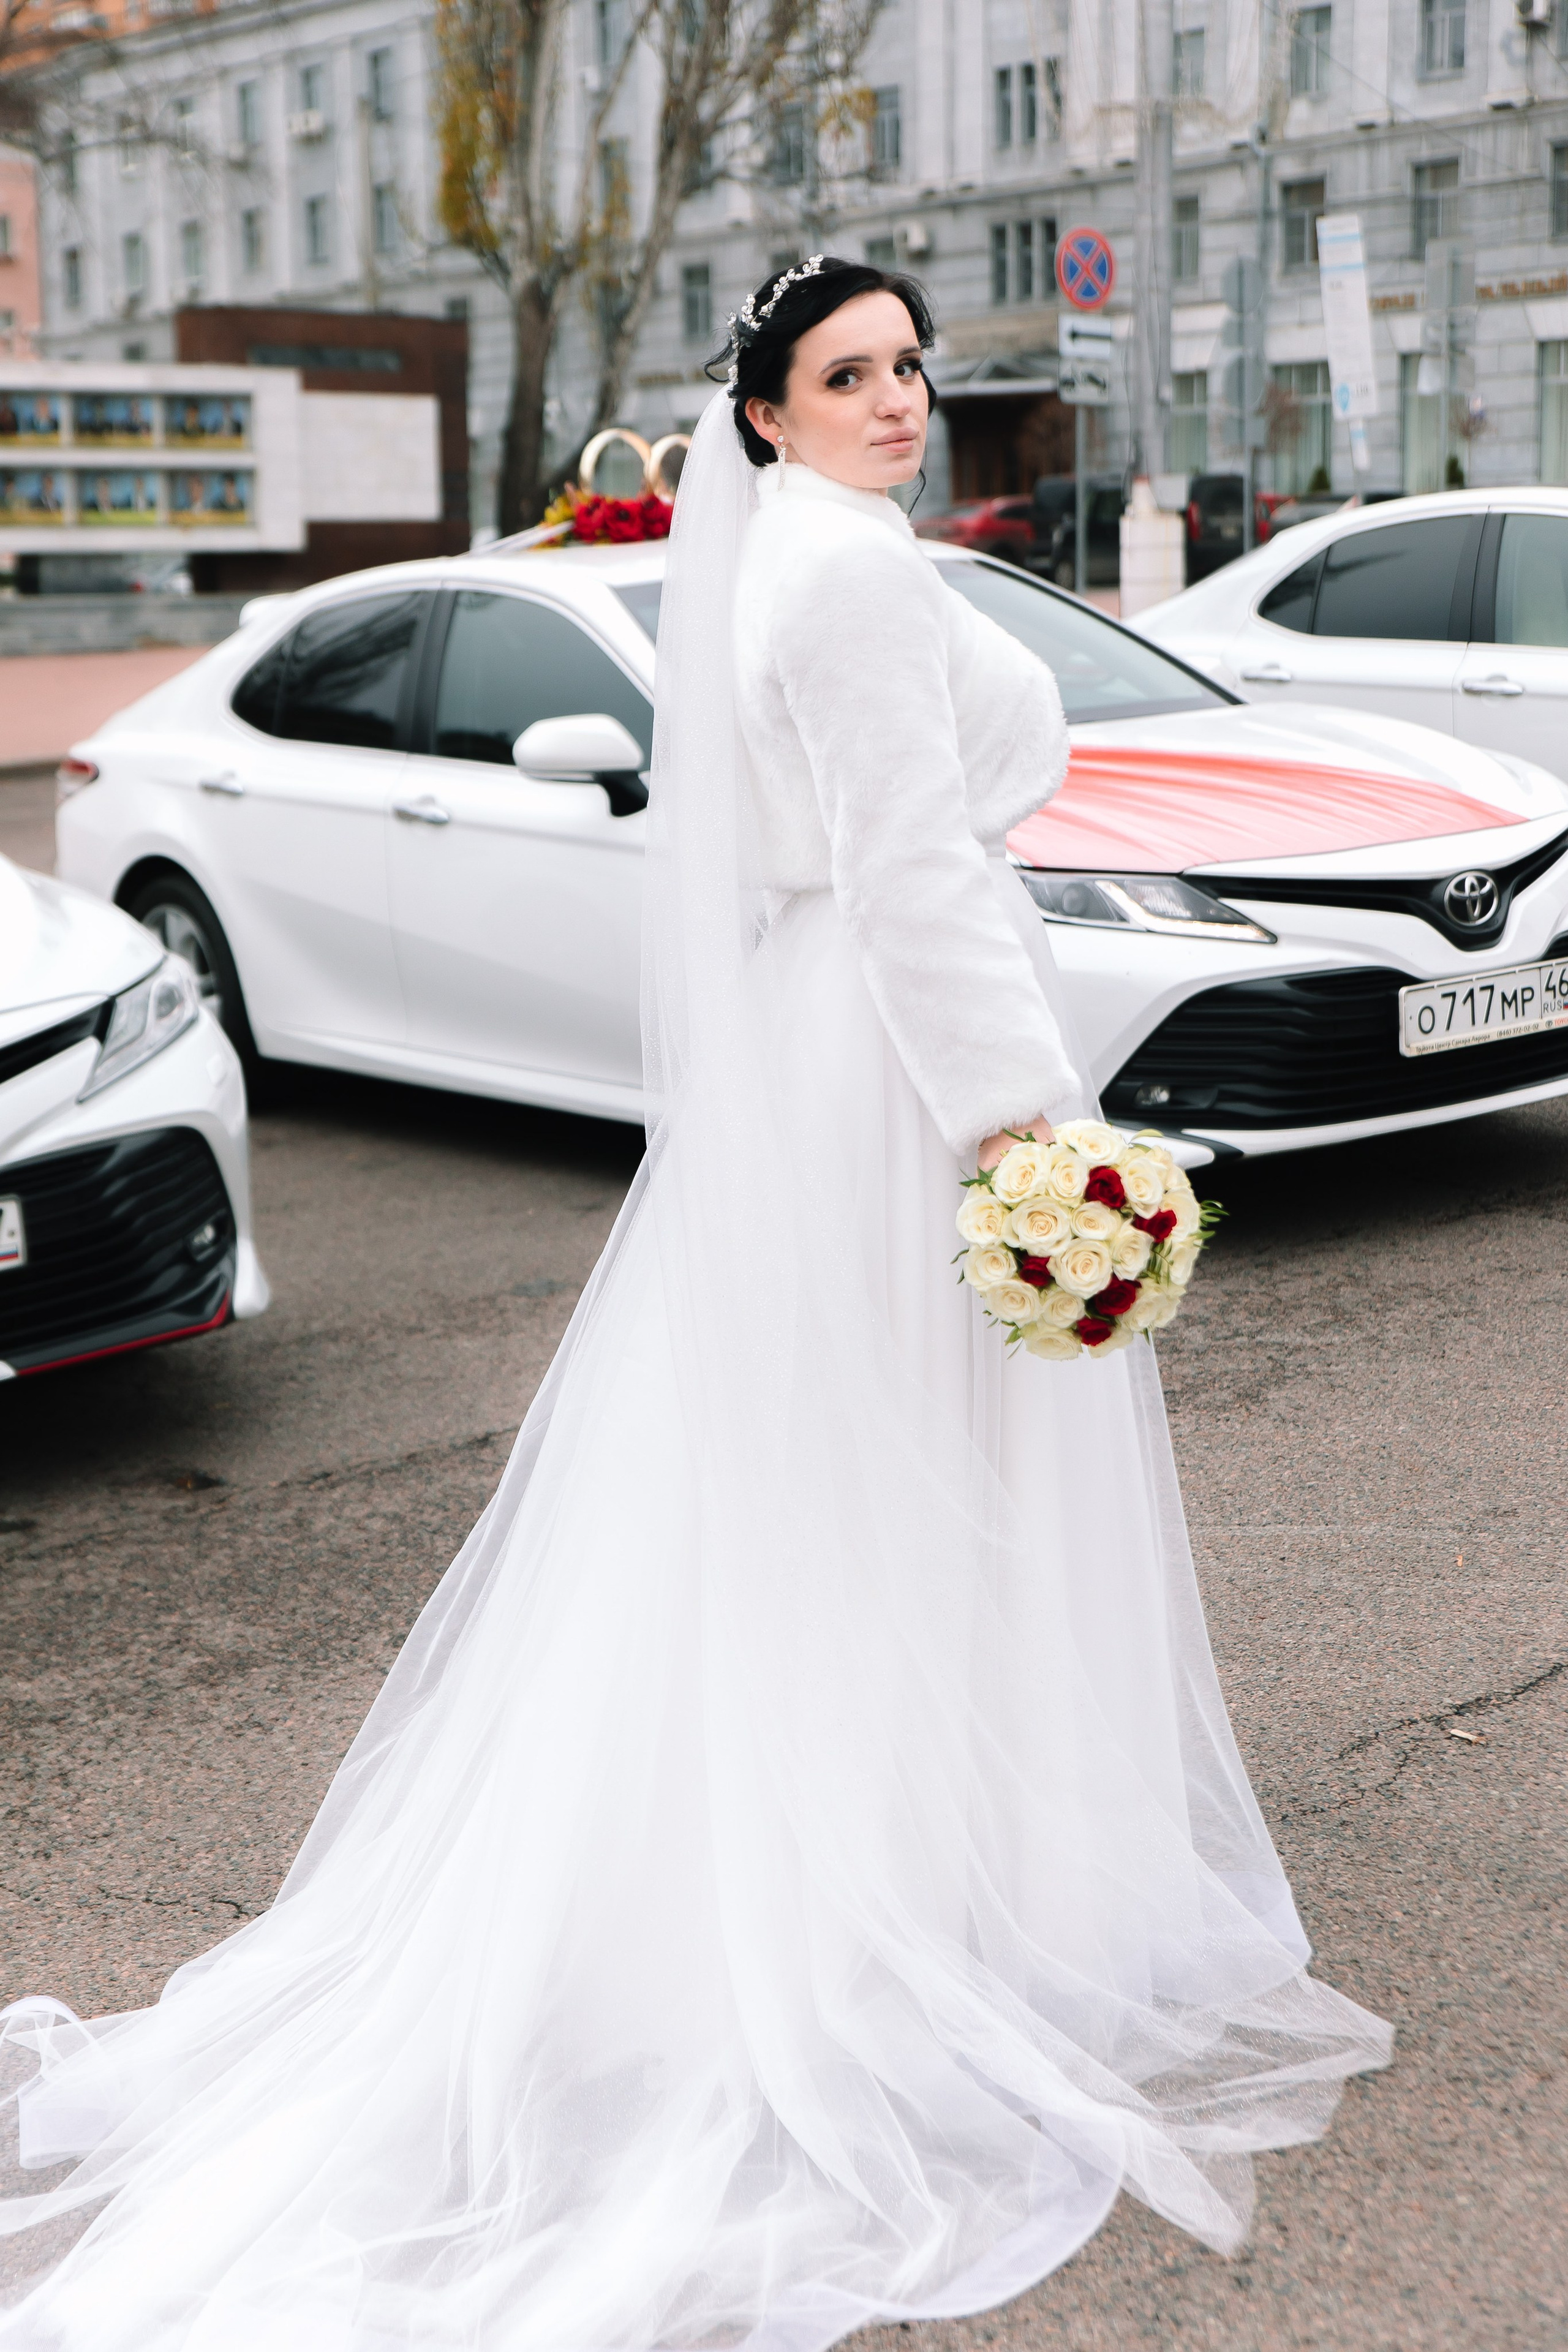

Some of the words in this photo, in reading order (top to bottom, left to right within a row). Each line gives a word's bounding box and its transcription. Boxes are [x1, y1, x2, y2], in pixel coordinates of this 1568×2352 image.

[1545, 968, 1568, 1000] 46
[1543, 1000, 1562, 1014] RUS
[1435, 1041, 1451, 1050] Центр
